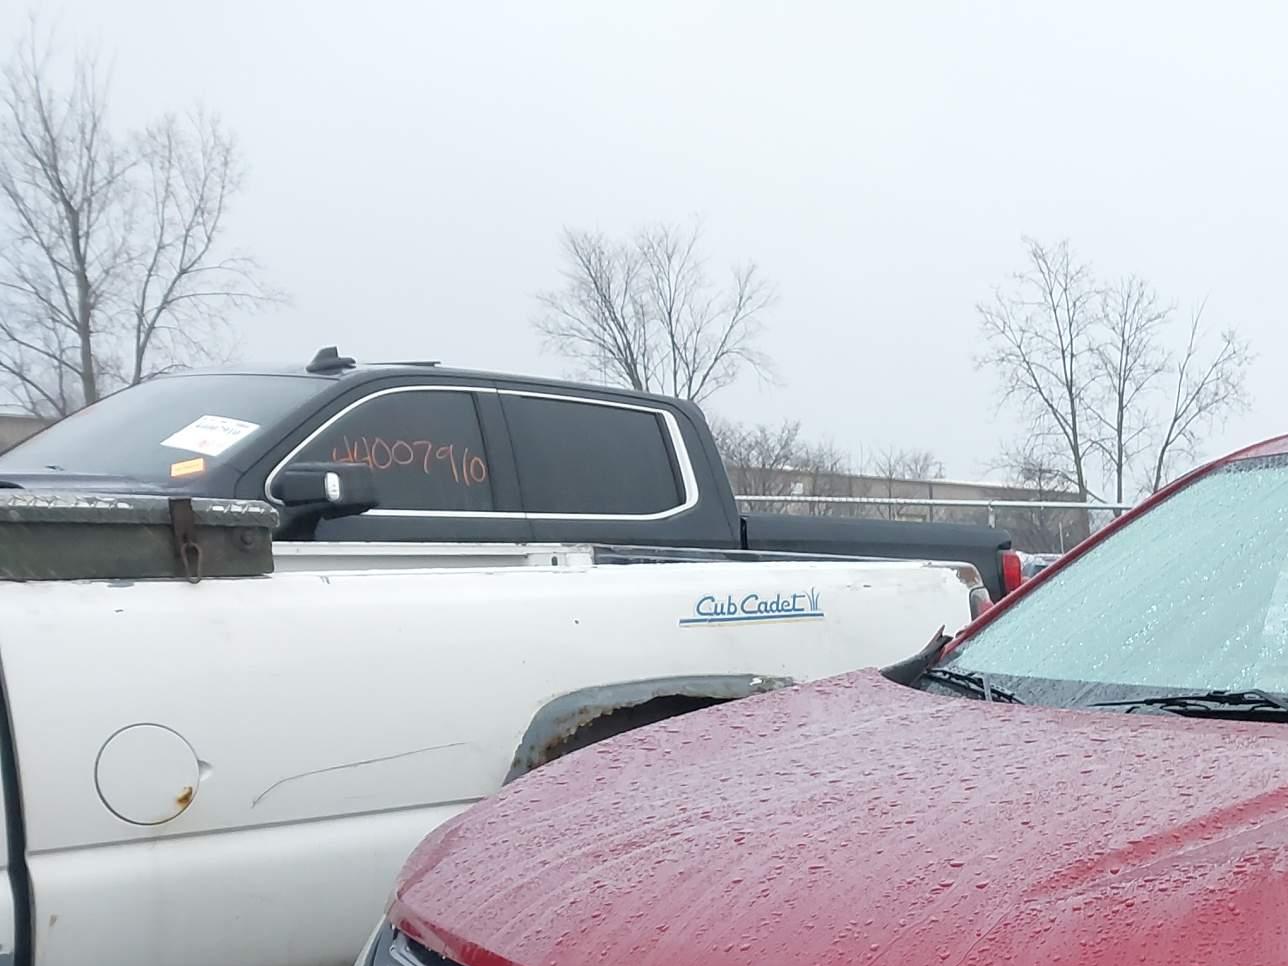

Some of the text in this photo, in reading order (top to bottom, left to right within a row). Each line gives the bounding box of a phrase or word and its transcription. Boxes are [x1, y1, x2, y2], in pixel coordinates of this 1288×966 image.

[332, 434, 487, 487] 44007910
[695, 592, 807, 617] Cub Cadet
